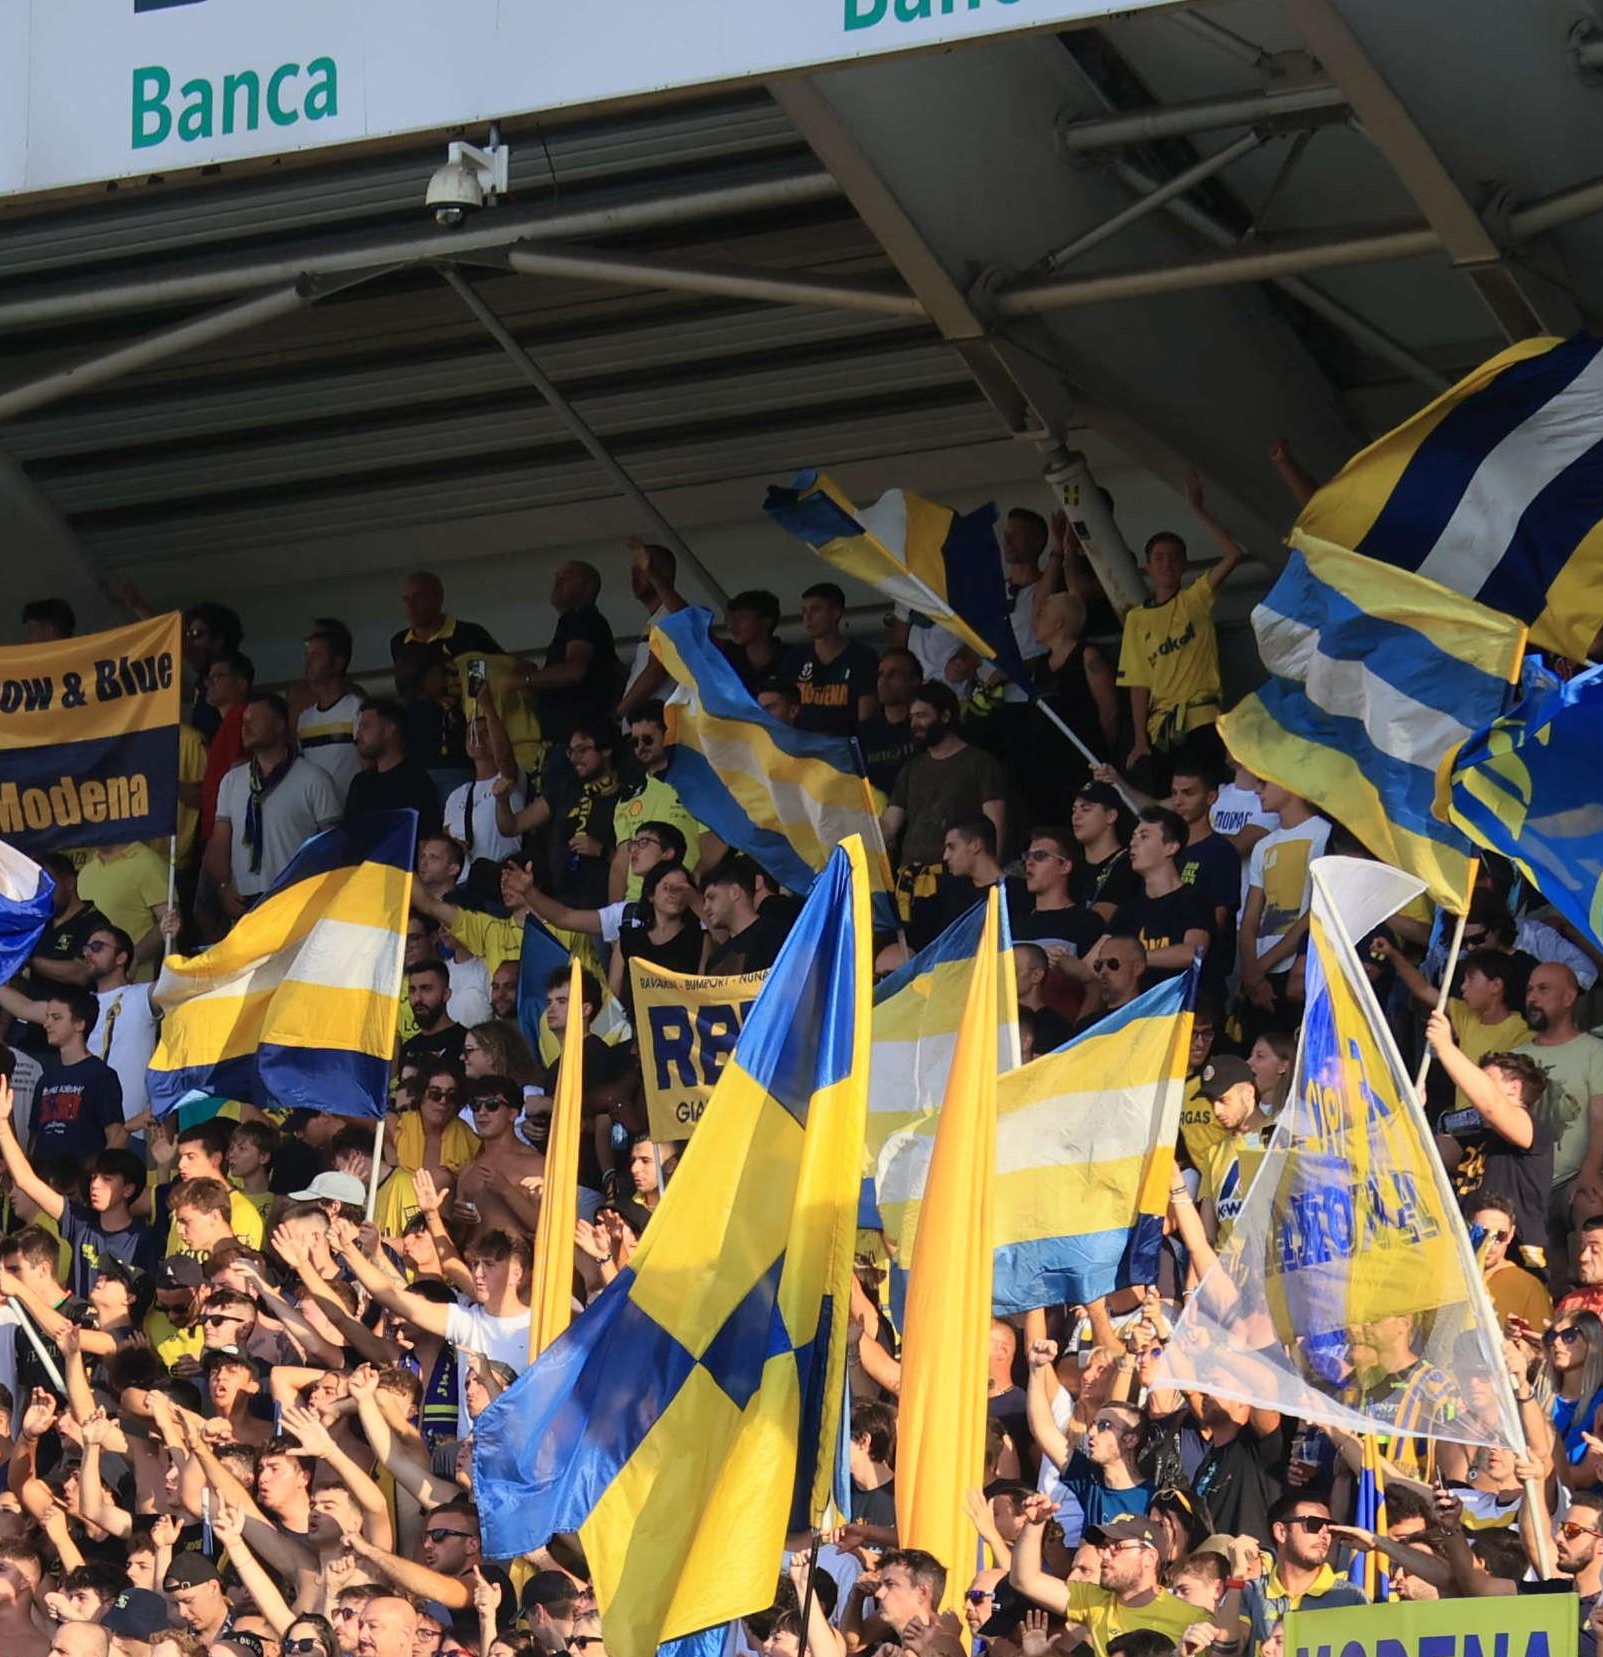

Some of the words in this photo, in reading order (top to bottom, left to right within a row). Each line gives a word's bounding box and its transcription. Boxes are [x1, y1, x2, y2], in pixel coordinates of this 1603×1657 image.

[133, 55, 338, 150] Banca
[62, 672, 87, 704] &
[94, 650, 174, 703] Blue
